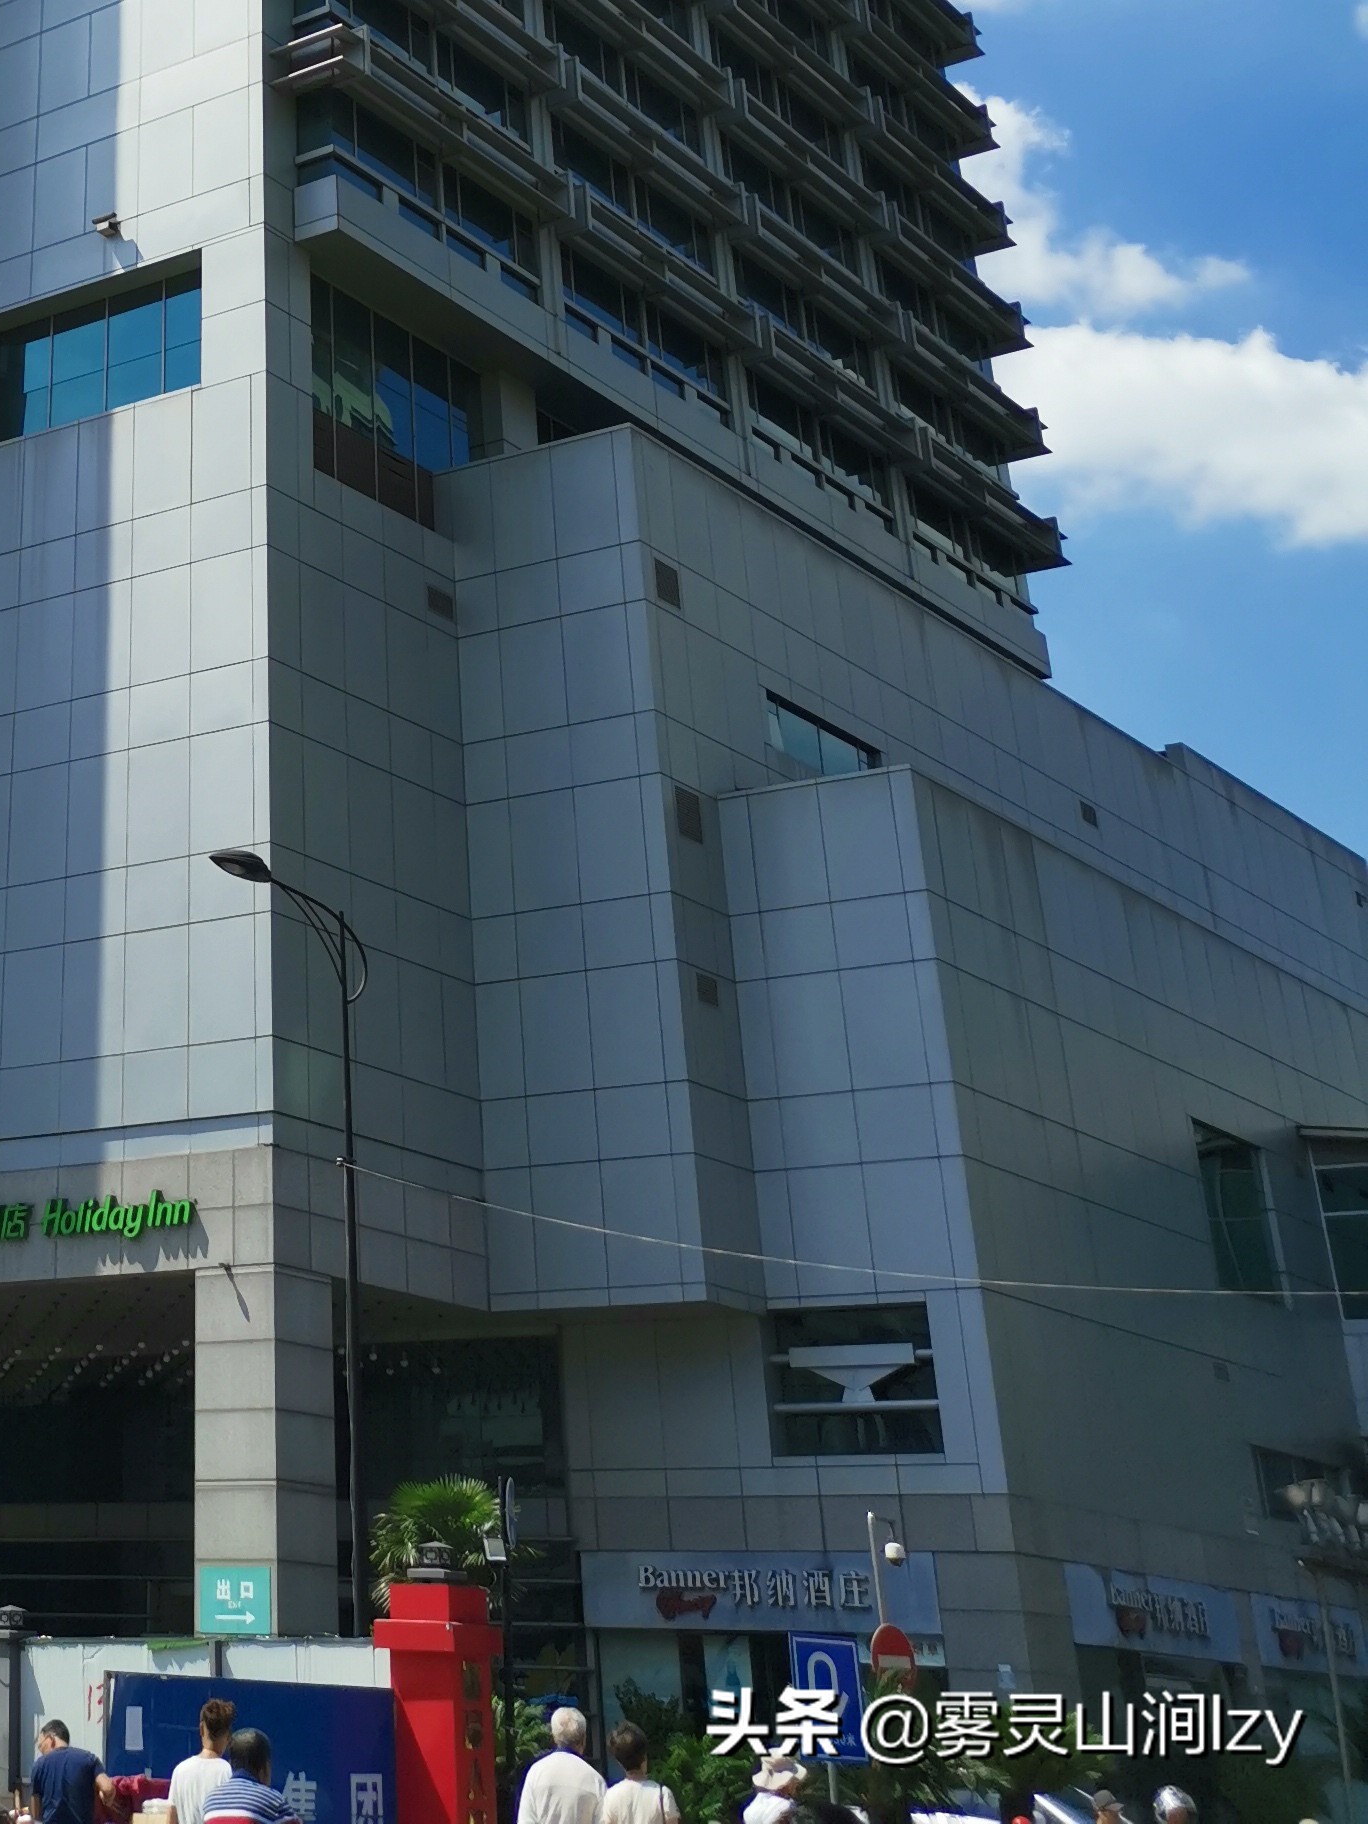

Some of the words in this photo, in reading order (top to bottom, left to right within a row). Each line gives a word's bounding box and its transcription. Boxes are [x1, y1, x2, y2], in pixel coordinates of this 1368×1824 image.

[43, 1195, 142, 1238] Holiday
[146, 1189, 192, 1227] Inn
[216, 1578, 254, 1601] 出口
[638, 1564, 729, 1590] Banner
[731, 1569, 872, 1609] 邦纳酒庄
